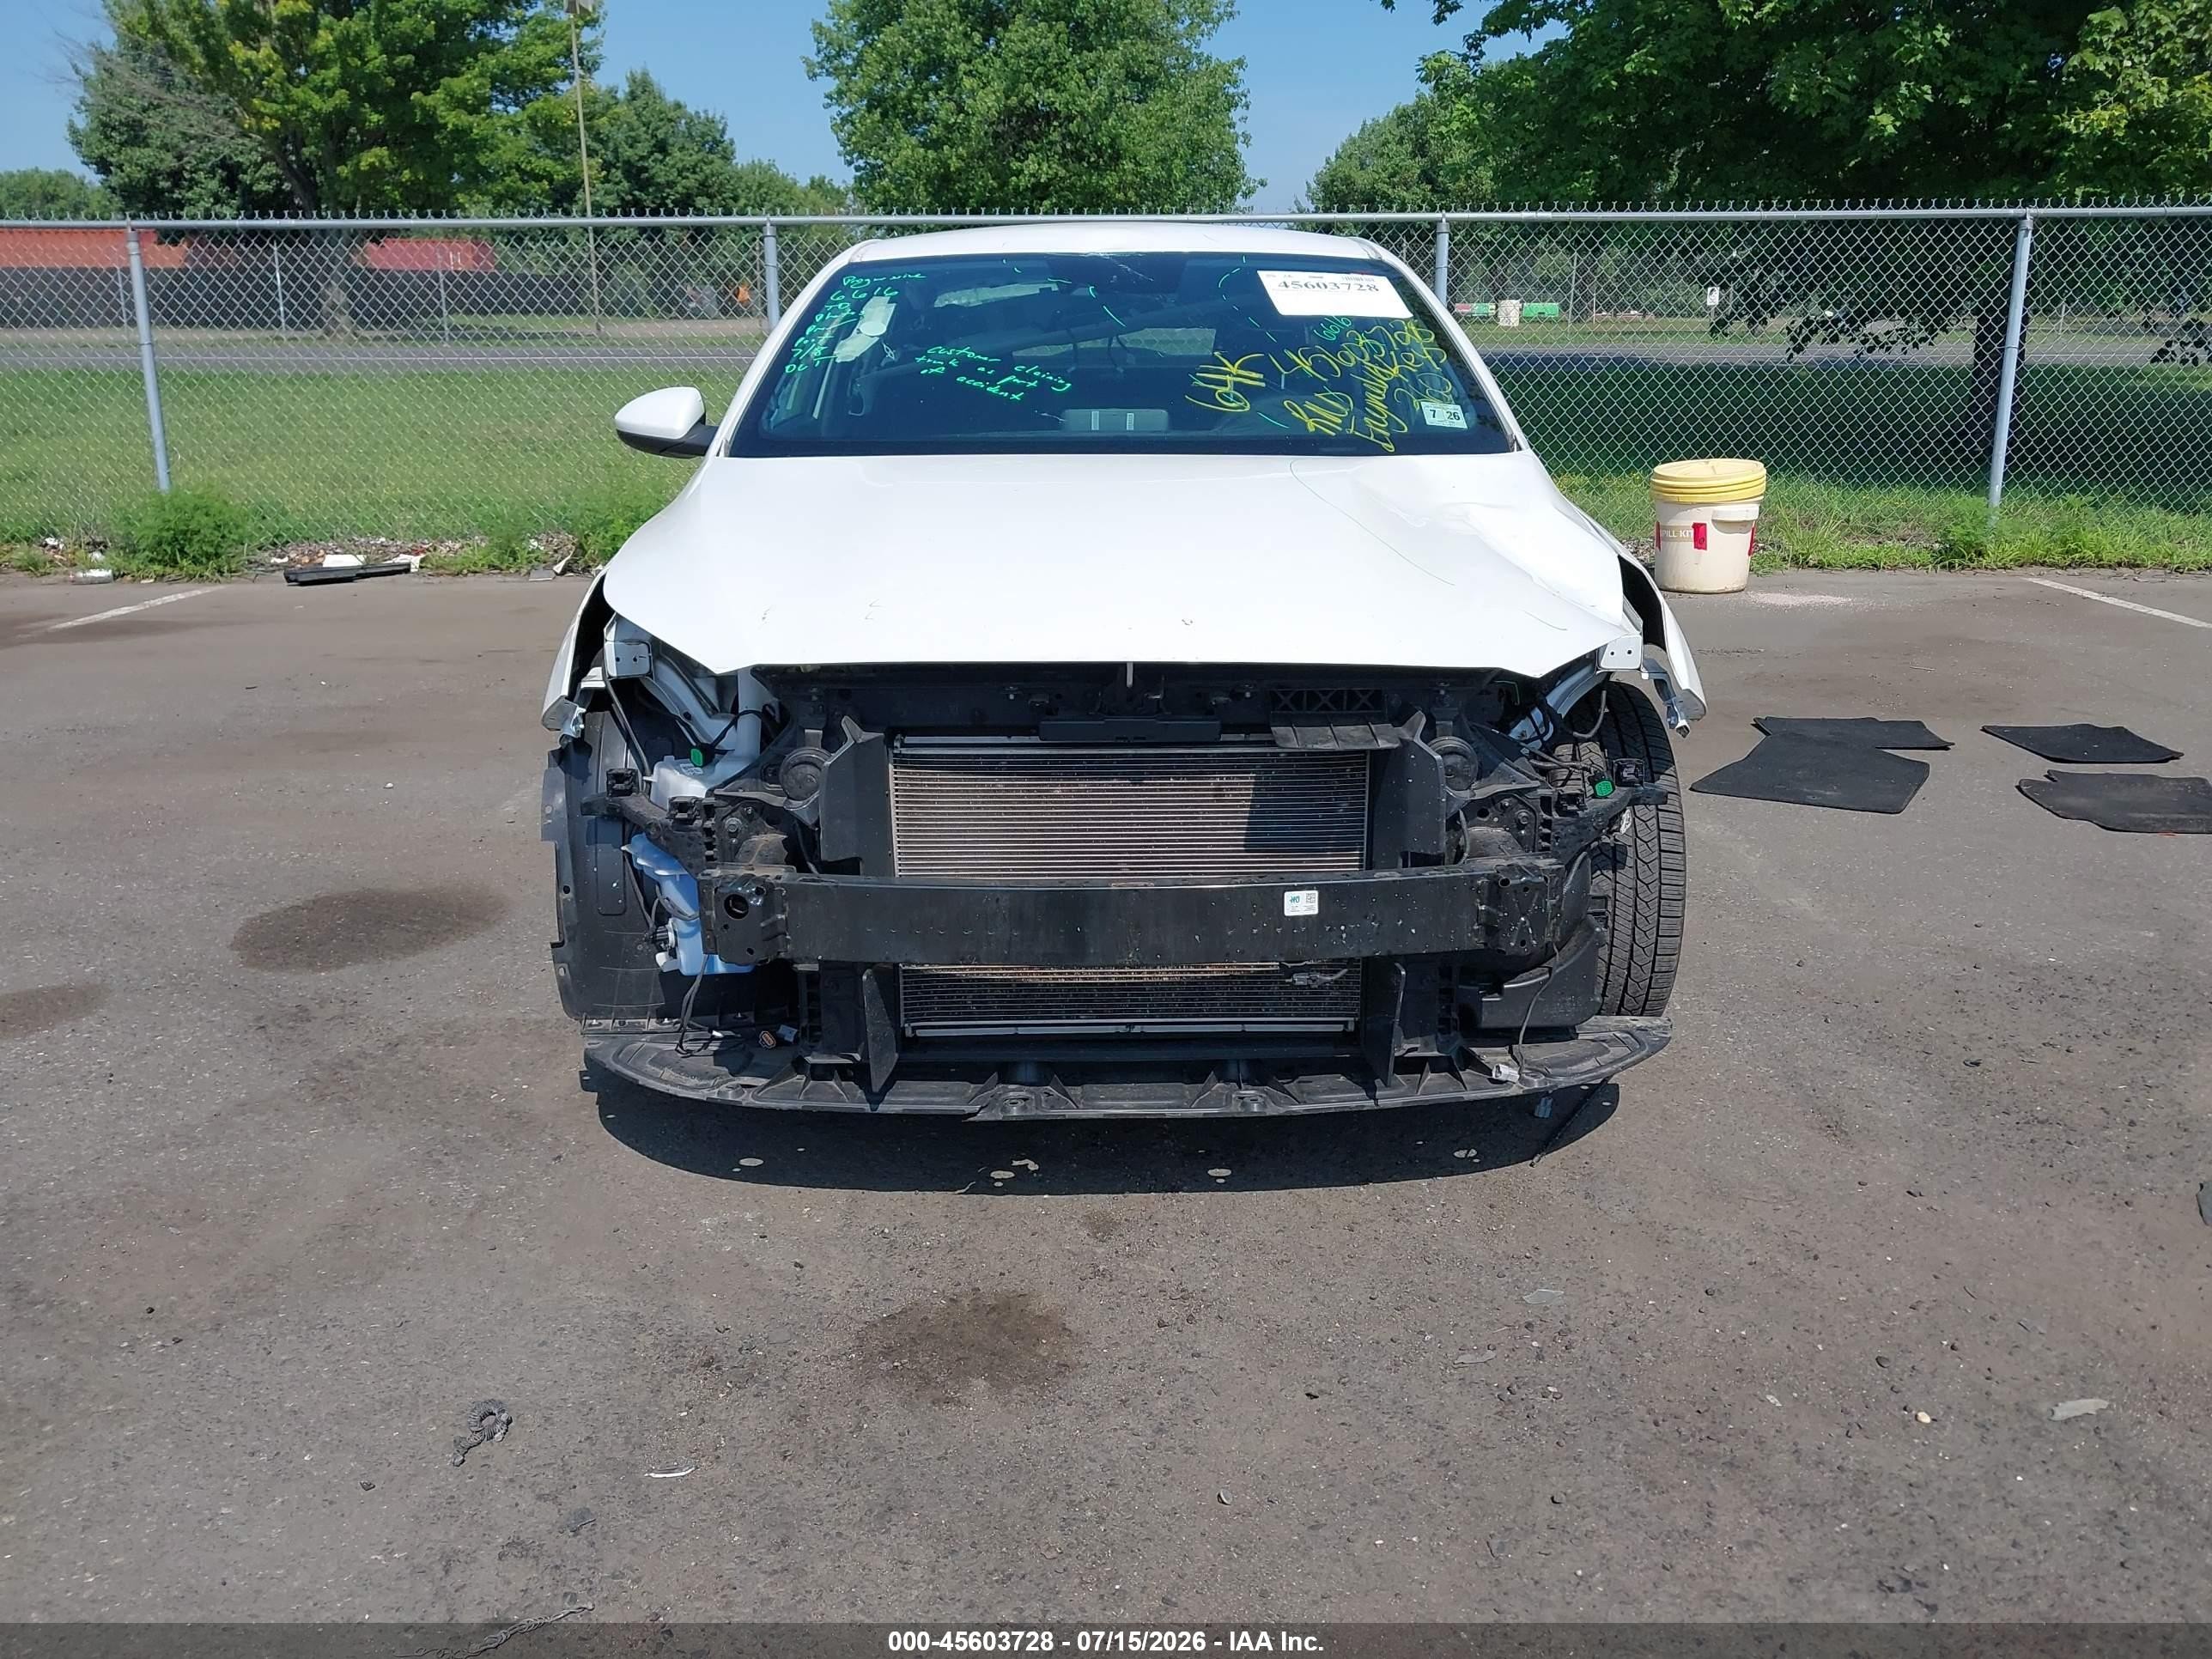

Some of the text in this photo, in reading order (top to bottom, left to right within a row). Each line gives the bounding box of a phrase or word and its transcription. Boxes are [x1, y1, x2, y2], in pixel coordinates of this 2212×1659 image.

[1277, 281, 1380, 292] 45603728
[830, 287, 900, 301] 6616
[1315, 314, 1352, 341] 6616
[976, 367, 995, 375] as
[1429, 409, 1461, 421] 7 26
